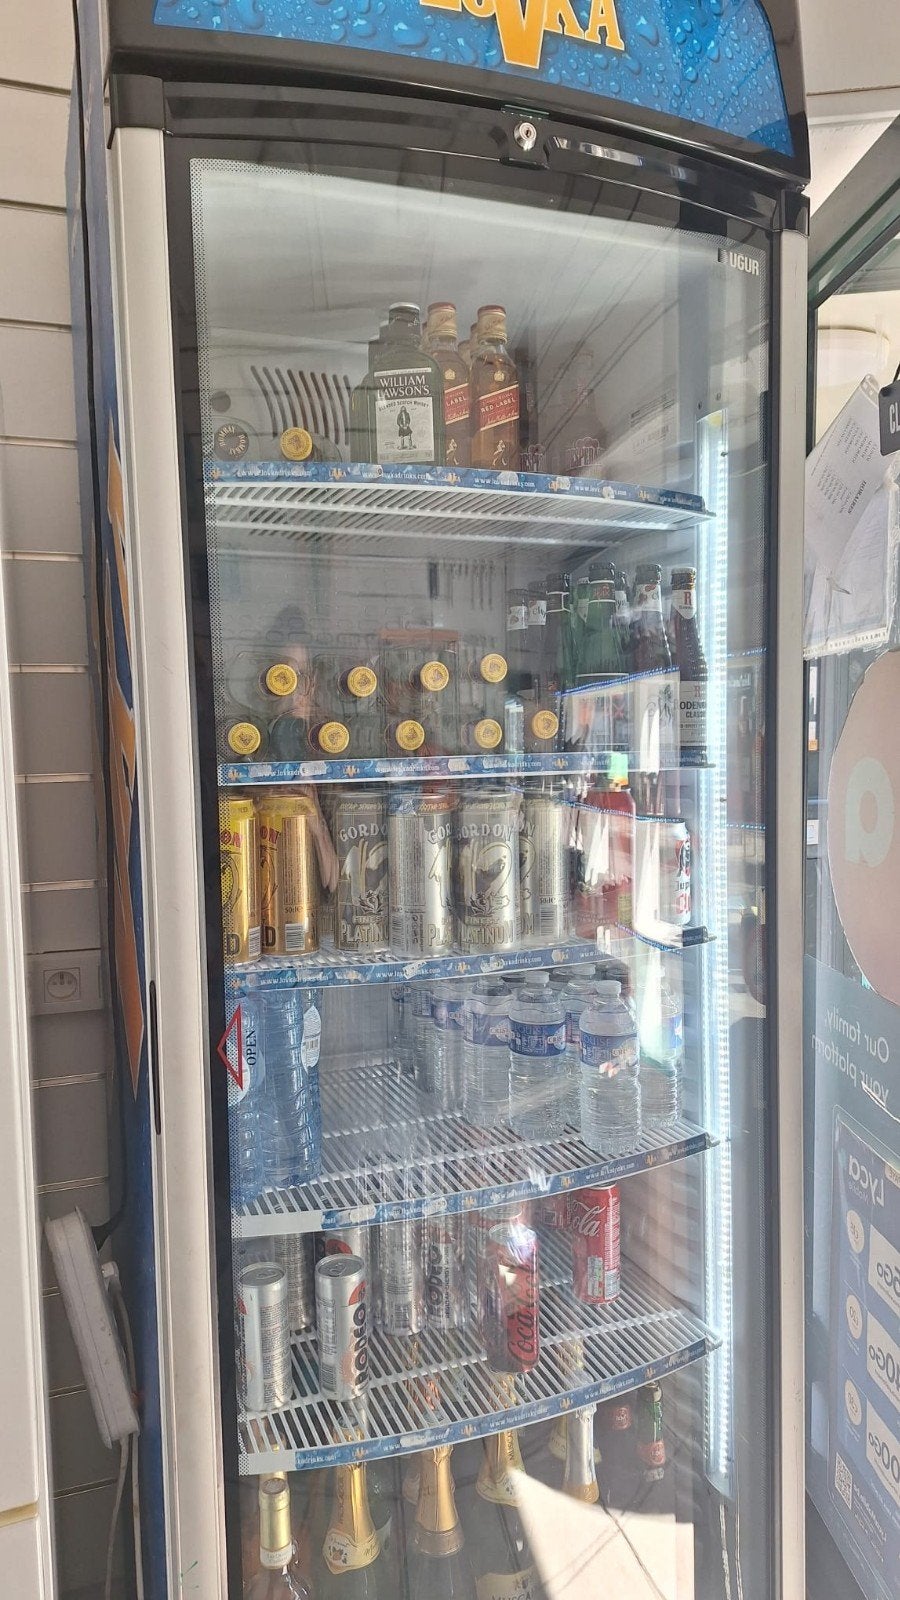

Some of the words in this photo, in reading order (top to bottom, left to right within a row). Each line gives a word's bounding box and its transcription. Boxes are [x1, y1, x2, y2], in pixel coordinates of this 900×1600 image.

[380, 375, 426, 388] WILLIAM
[378, 384, 431, 399] LAWSON'S
[446, 396, 467, 407] LABEL
[481, 404, 495, 413] RED
[496, 397, 517, 408] LABEL
[246, 1029, 257, 1066] OPEN
[353, 1302, 369, 1386] RODEO
